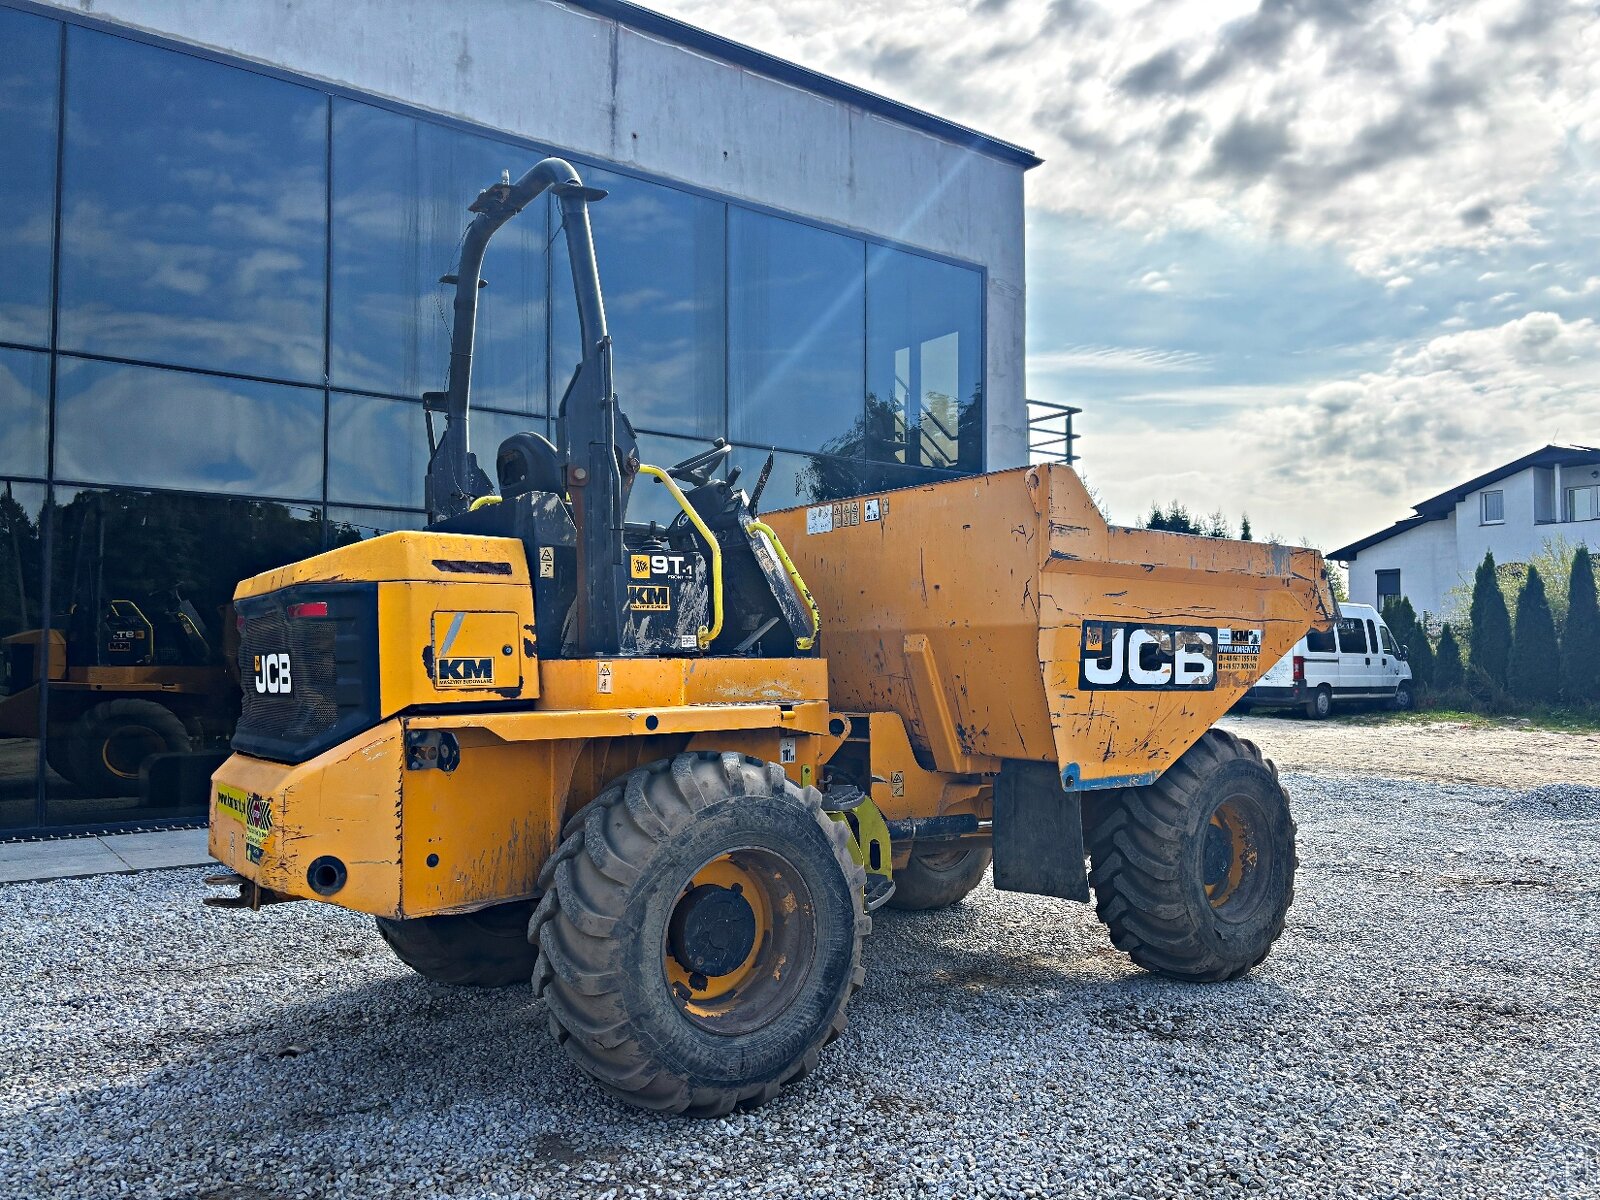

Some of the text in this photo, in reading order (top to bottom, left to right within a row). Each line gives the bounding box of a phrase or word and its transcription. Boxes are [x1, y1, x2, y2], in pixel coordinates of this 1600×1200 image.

[629, 587, 668, 604] KM
[1232, 630, 1249, 641] KM
[1084, 628, 1214, 685] JCB
[255, 653, 292, 693] JCB
[439, 659, 492, 679] KM
